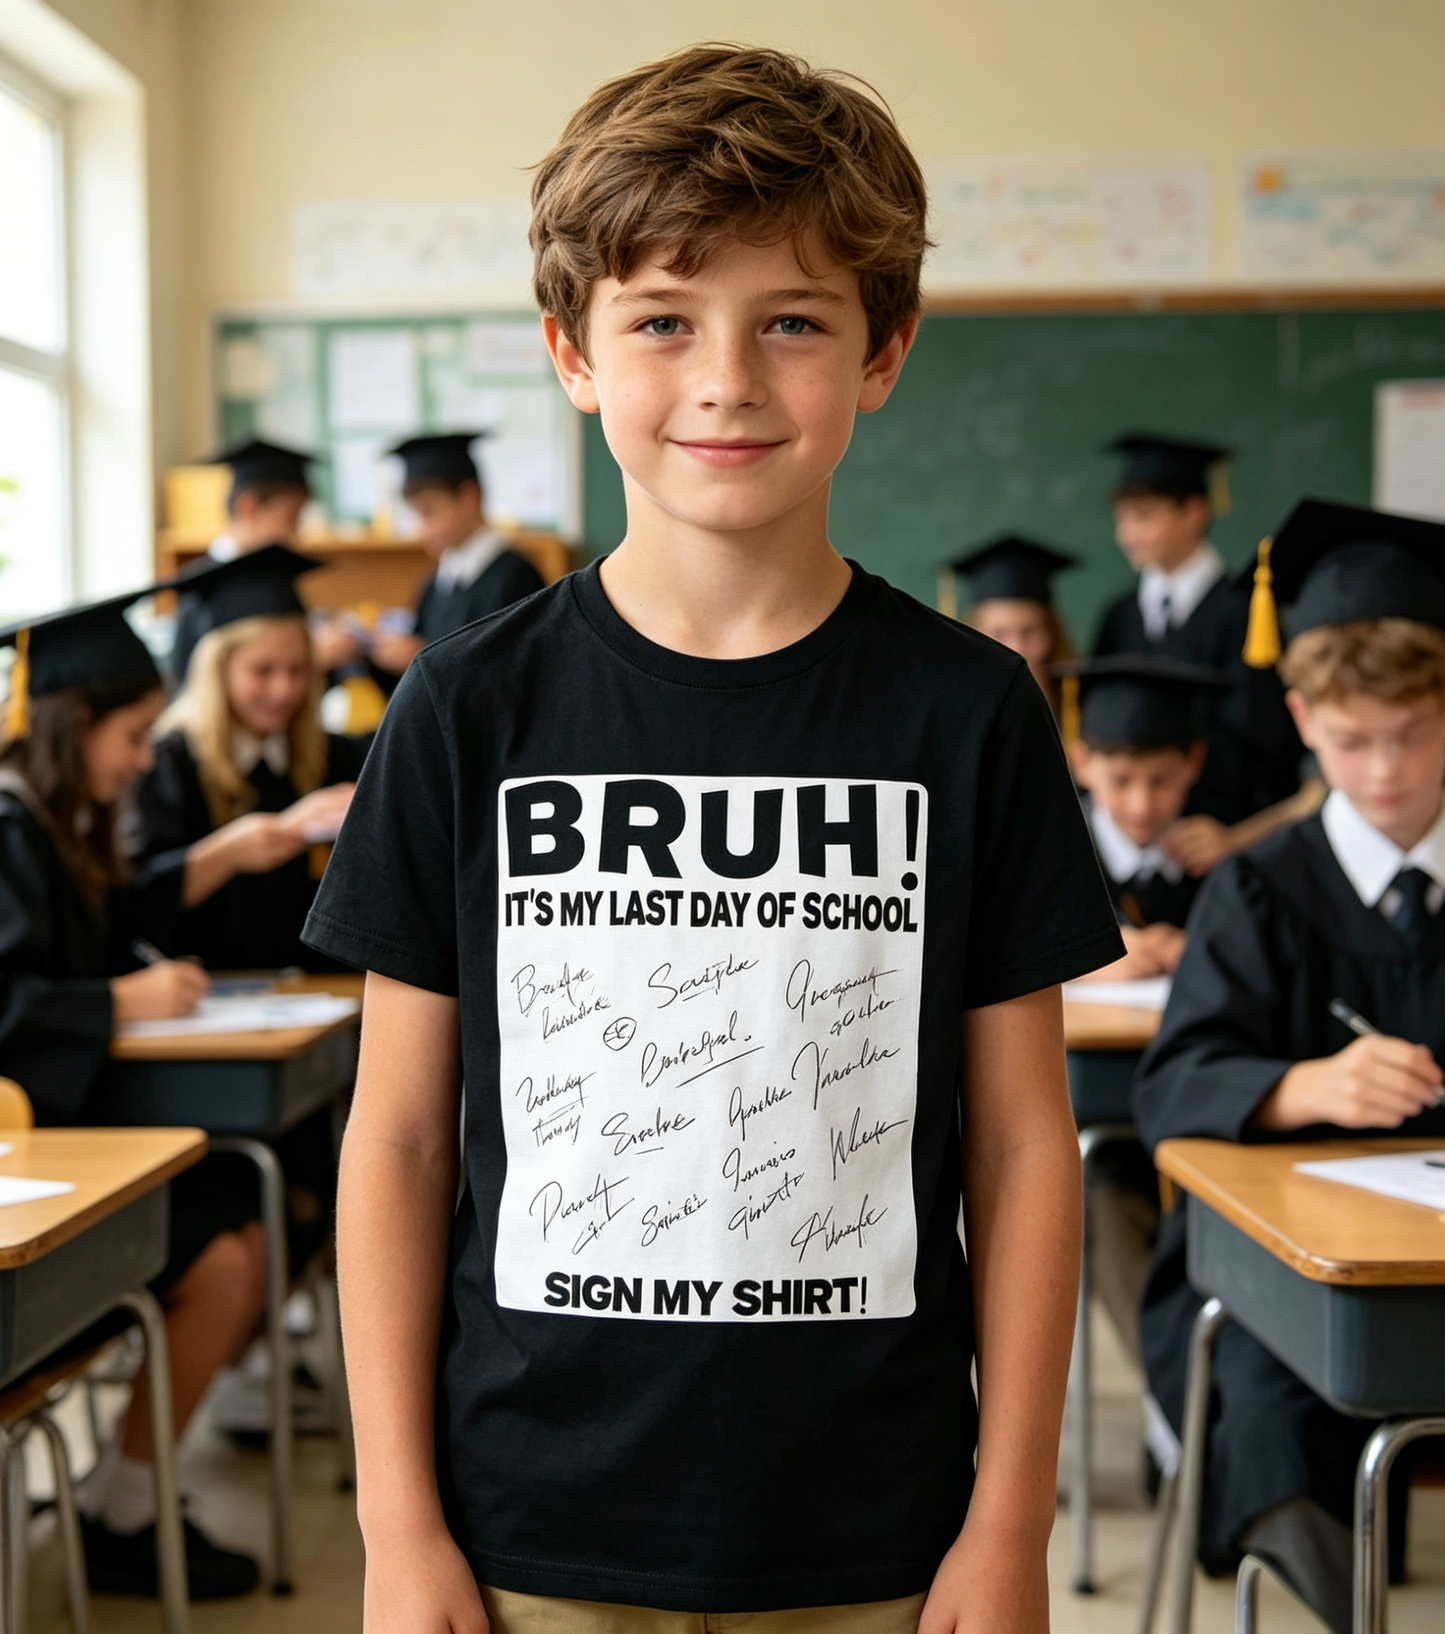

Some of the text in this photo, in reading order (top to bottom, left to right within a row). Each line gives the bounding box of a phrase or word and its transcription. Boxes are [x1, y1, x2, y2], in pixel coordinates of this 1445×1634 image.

[504, 779, 919, 892] BRUH!
[505, 888, 918, 933] IT'S MY LAST DAY OF SCHOOL
[543, 1271, 868, 1317] SIGN MY SHIRT!
